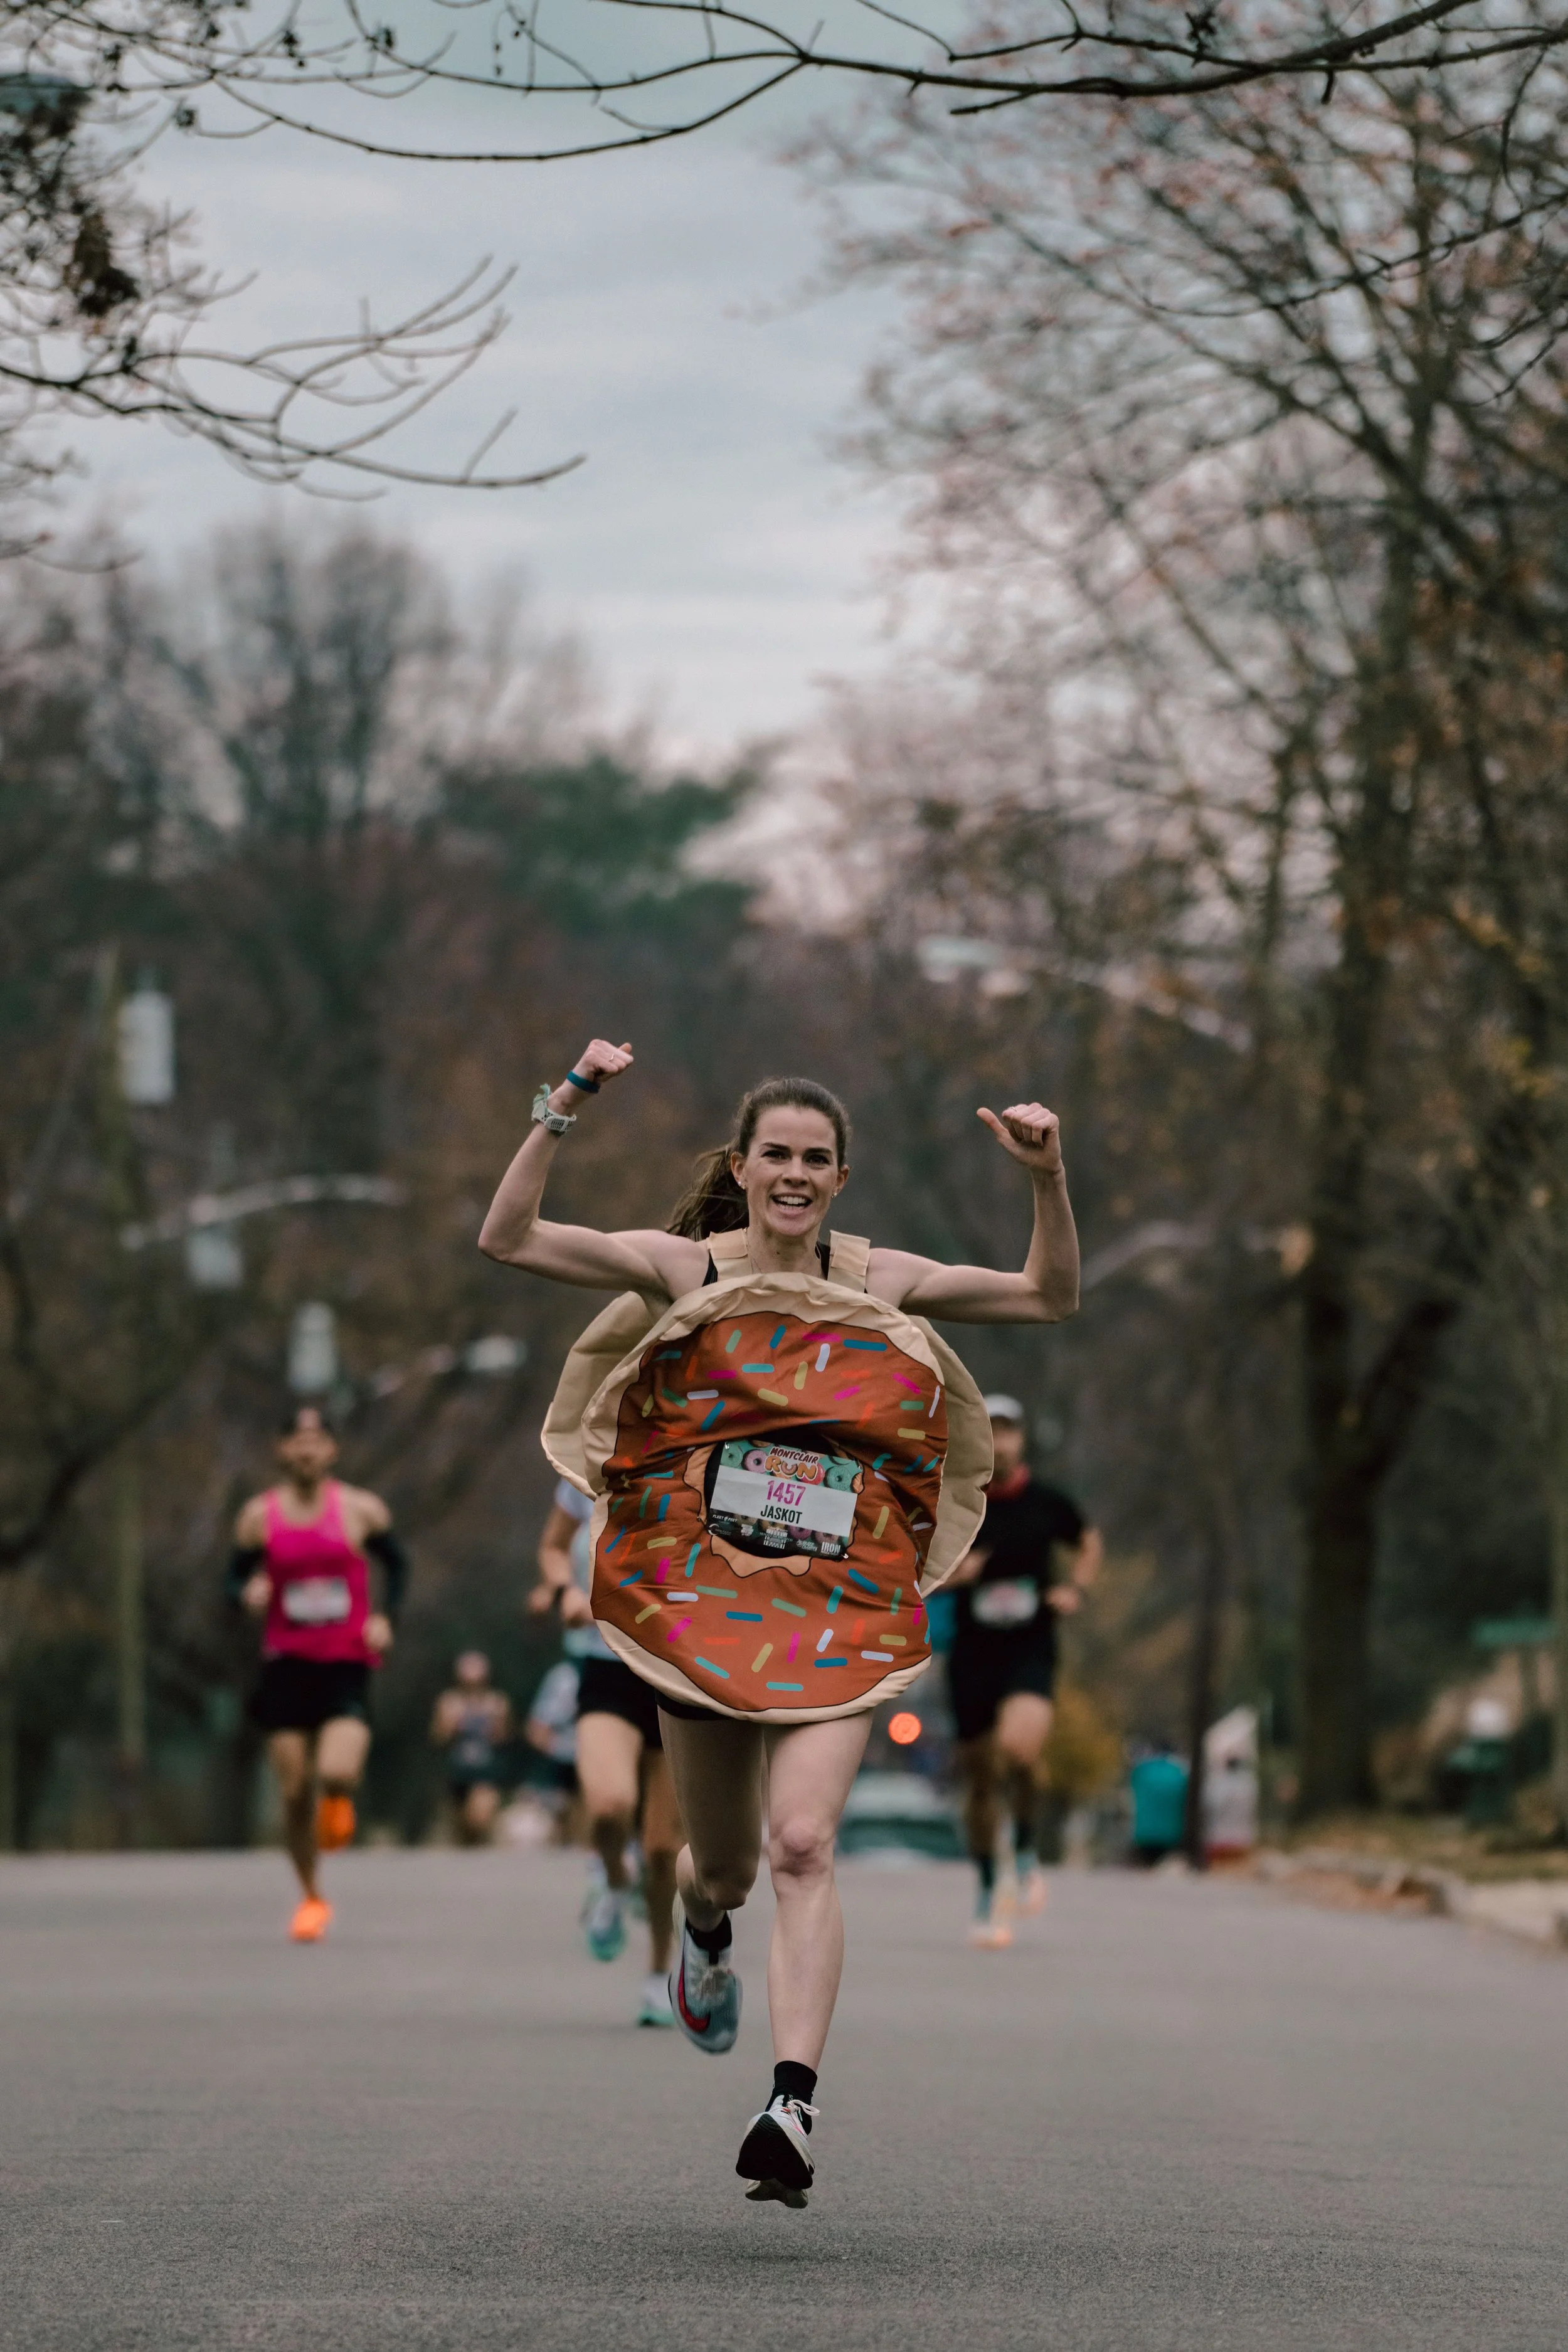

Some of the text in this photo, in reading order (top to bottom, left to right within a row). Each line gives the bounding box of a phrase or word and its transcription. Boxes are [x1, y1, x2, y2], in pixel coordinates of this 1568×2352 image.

[770, 1447, 818, 1464] MONTCLAIR
[765, 1455, 817, 1480] RUN
[767, 1480, 806, 1506] 1457
[760, 1505, 803, 1524] JASKOT
[821, 1542, 840, 1554] IRON
